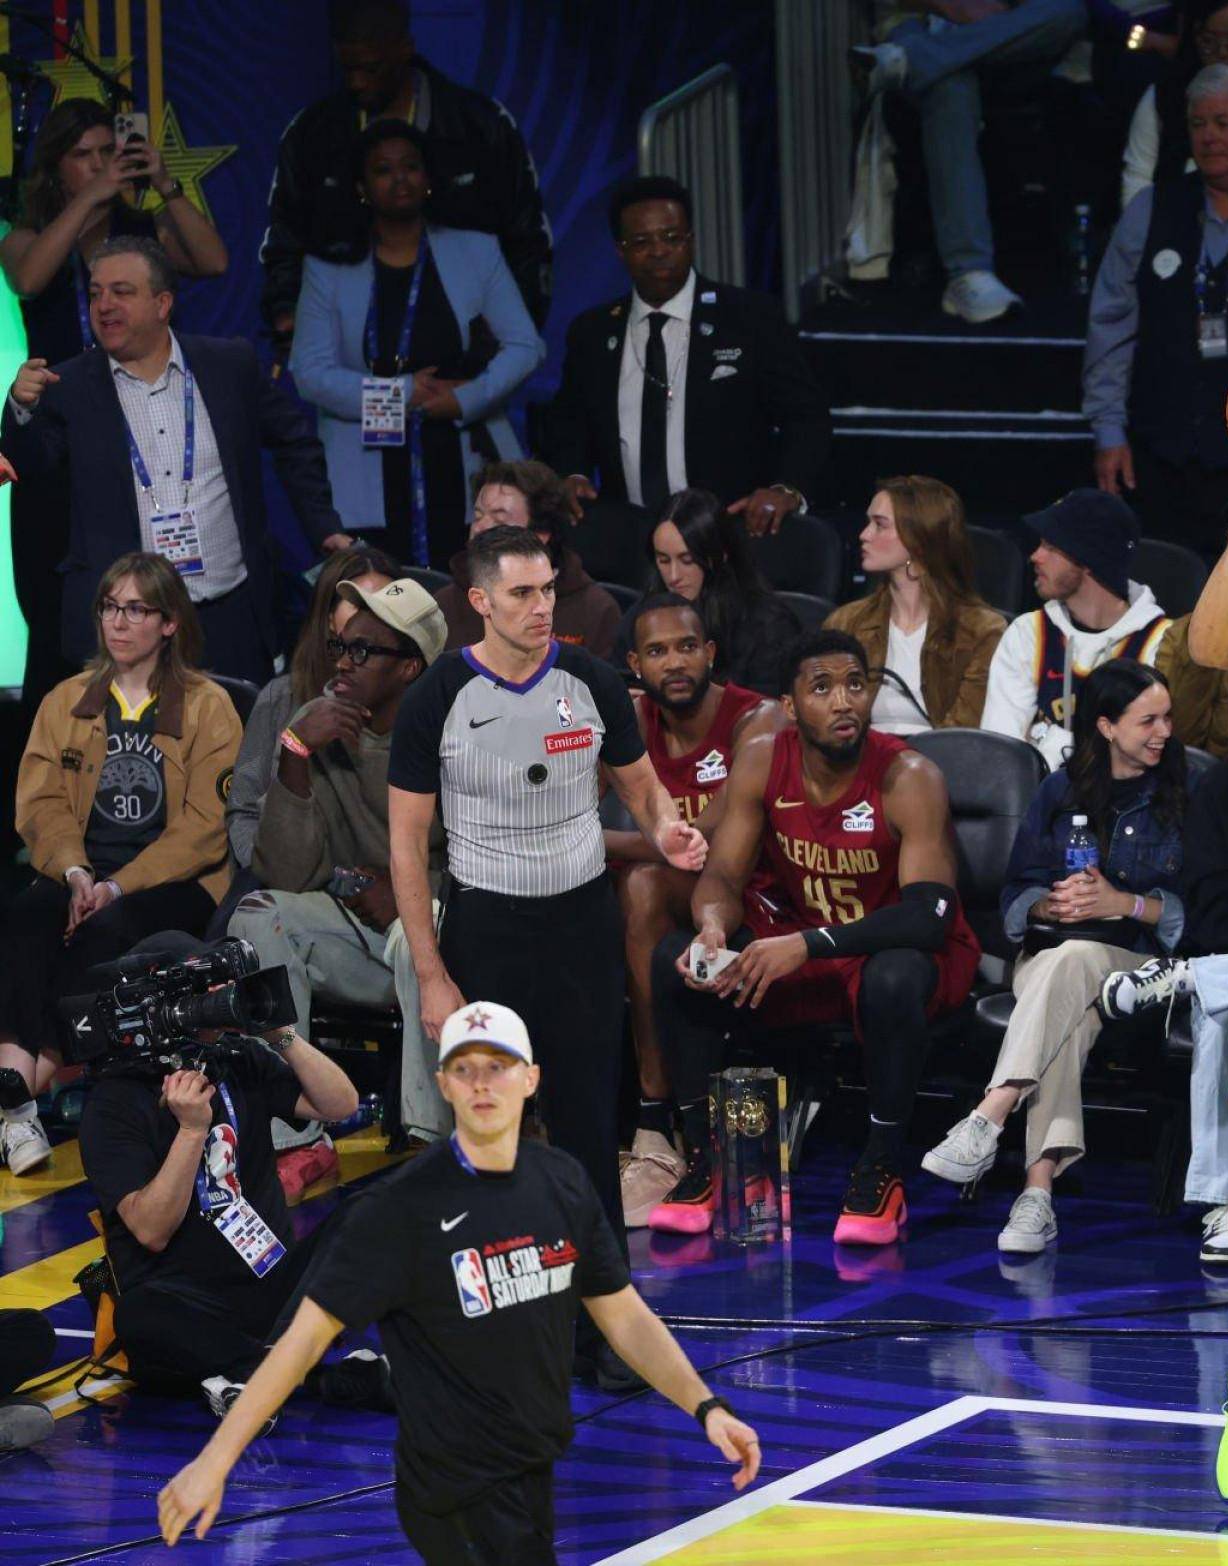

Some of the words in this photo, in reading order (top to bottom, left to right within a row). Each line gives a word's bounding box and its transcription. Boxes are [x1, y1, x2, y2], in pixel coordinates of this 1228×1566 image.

[546, 734, 593, 751] Emirates
[697, 767, 727, 780] CLIFFS
[113, 795, 141, 819] 30
[776, 832, 880, 874] CLEVELAND
[803, 875, 864, 925] 45
[208, 1189, 229, 1203] NBA
